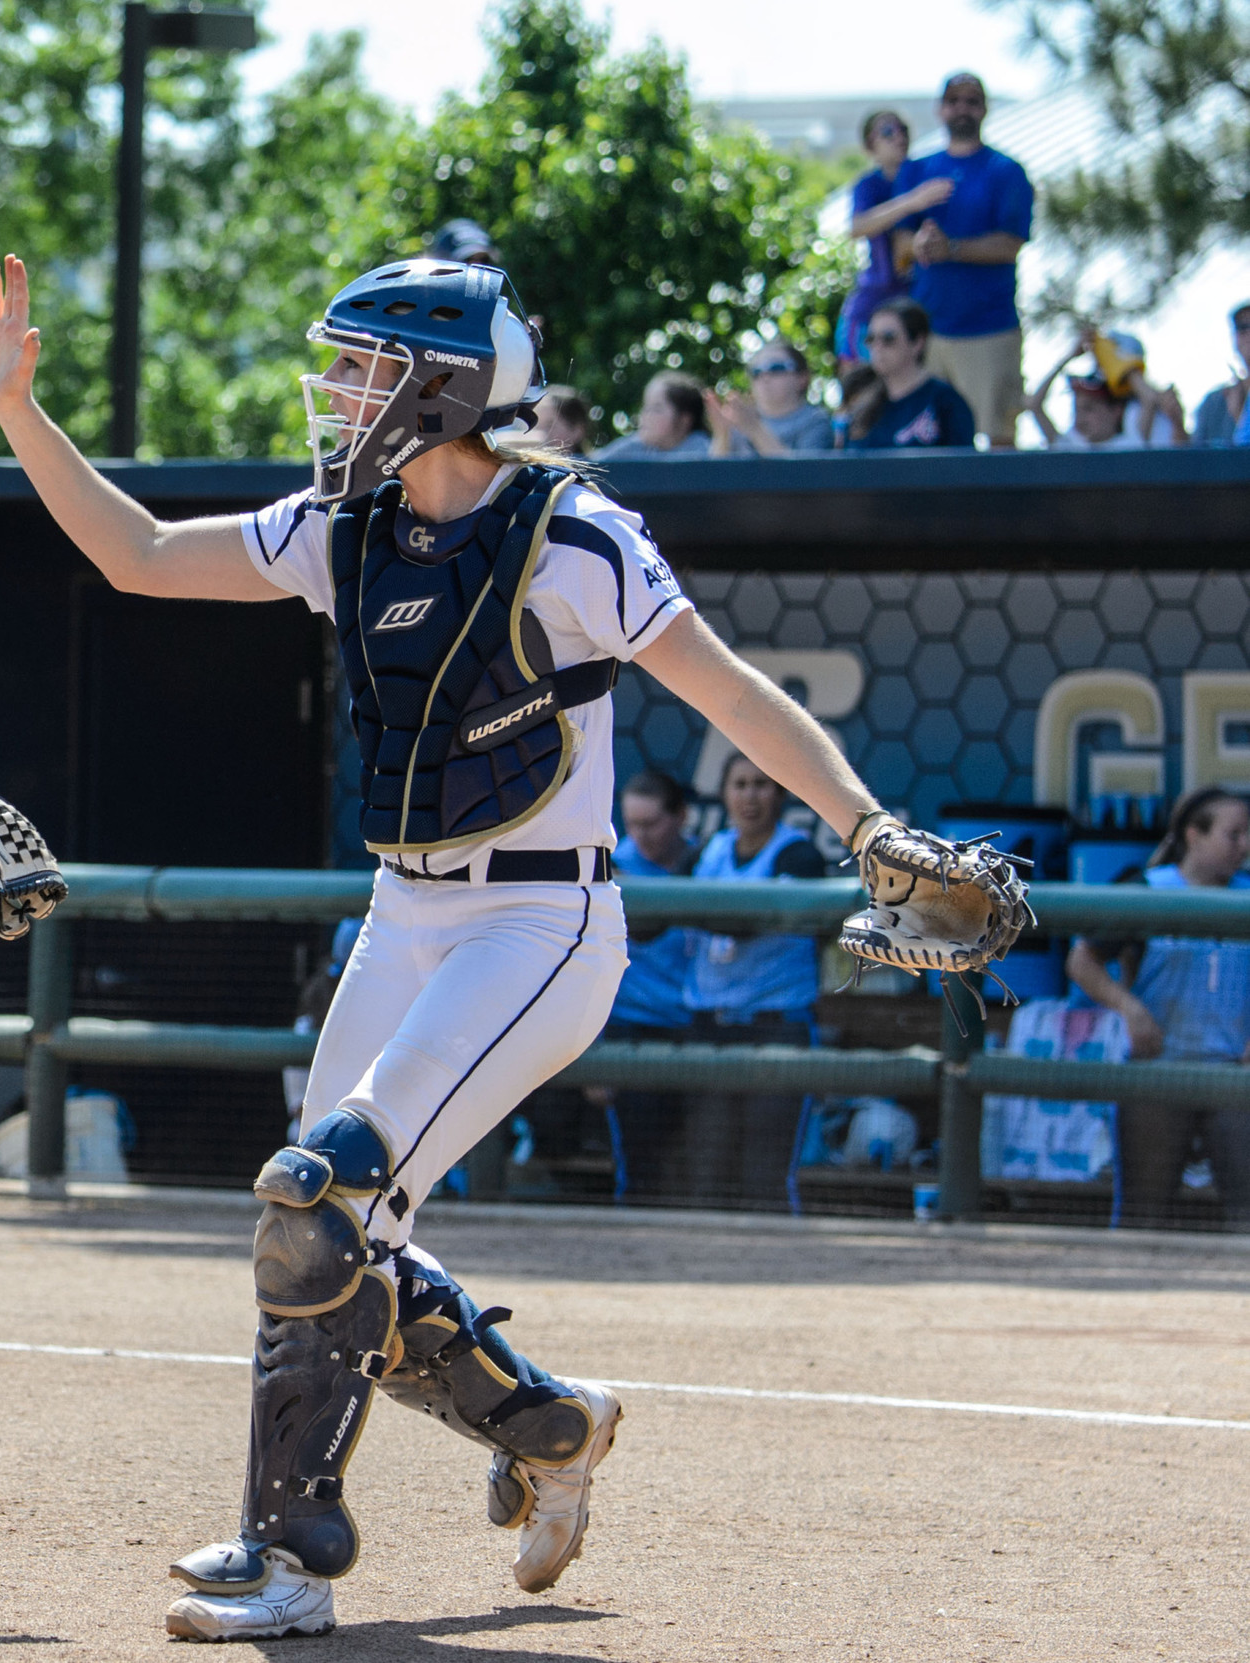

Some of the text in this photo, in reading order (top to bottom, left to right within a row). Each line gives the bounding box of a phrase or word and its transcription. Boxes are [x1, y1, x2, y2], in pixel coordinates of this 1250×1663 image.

[435, 352, 480, 371] WORTH
[389, 436, 425, 468] WORTH
[409, 526, 435, 553] GT
[467, 691, 554, 743] WORTH
[324, 1395, 358, 1461] WORTH
